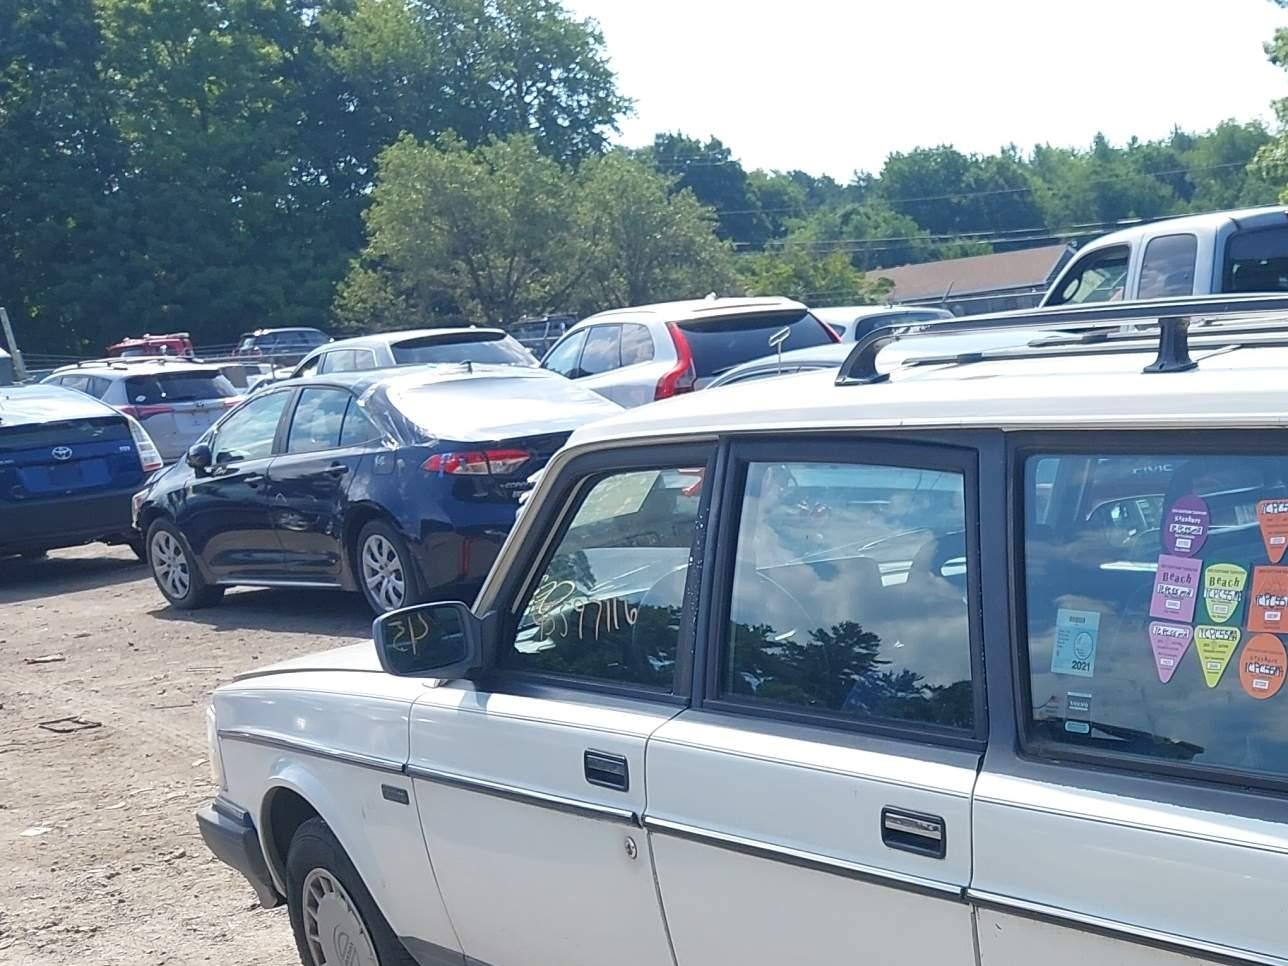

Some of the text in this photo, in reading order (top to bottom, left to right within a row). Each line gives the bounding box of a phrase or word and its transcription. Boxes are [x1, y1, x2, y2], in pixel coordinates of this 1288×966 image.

[1162, 572, 1192, 585] Beach
[1209, 576, 1240, 588] Beach
[1071, 660, 1091, 673] 2021
